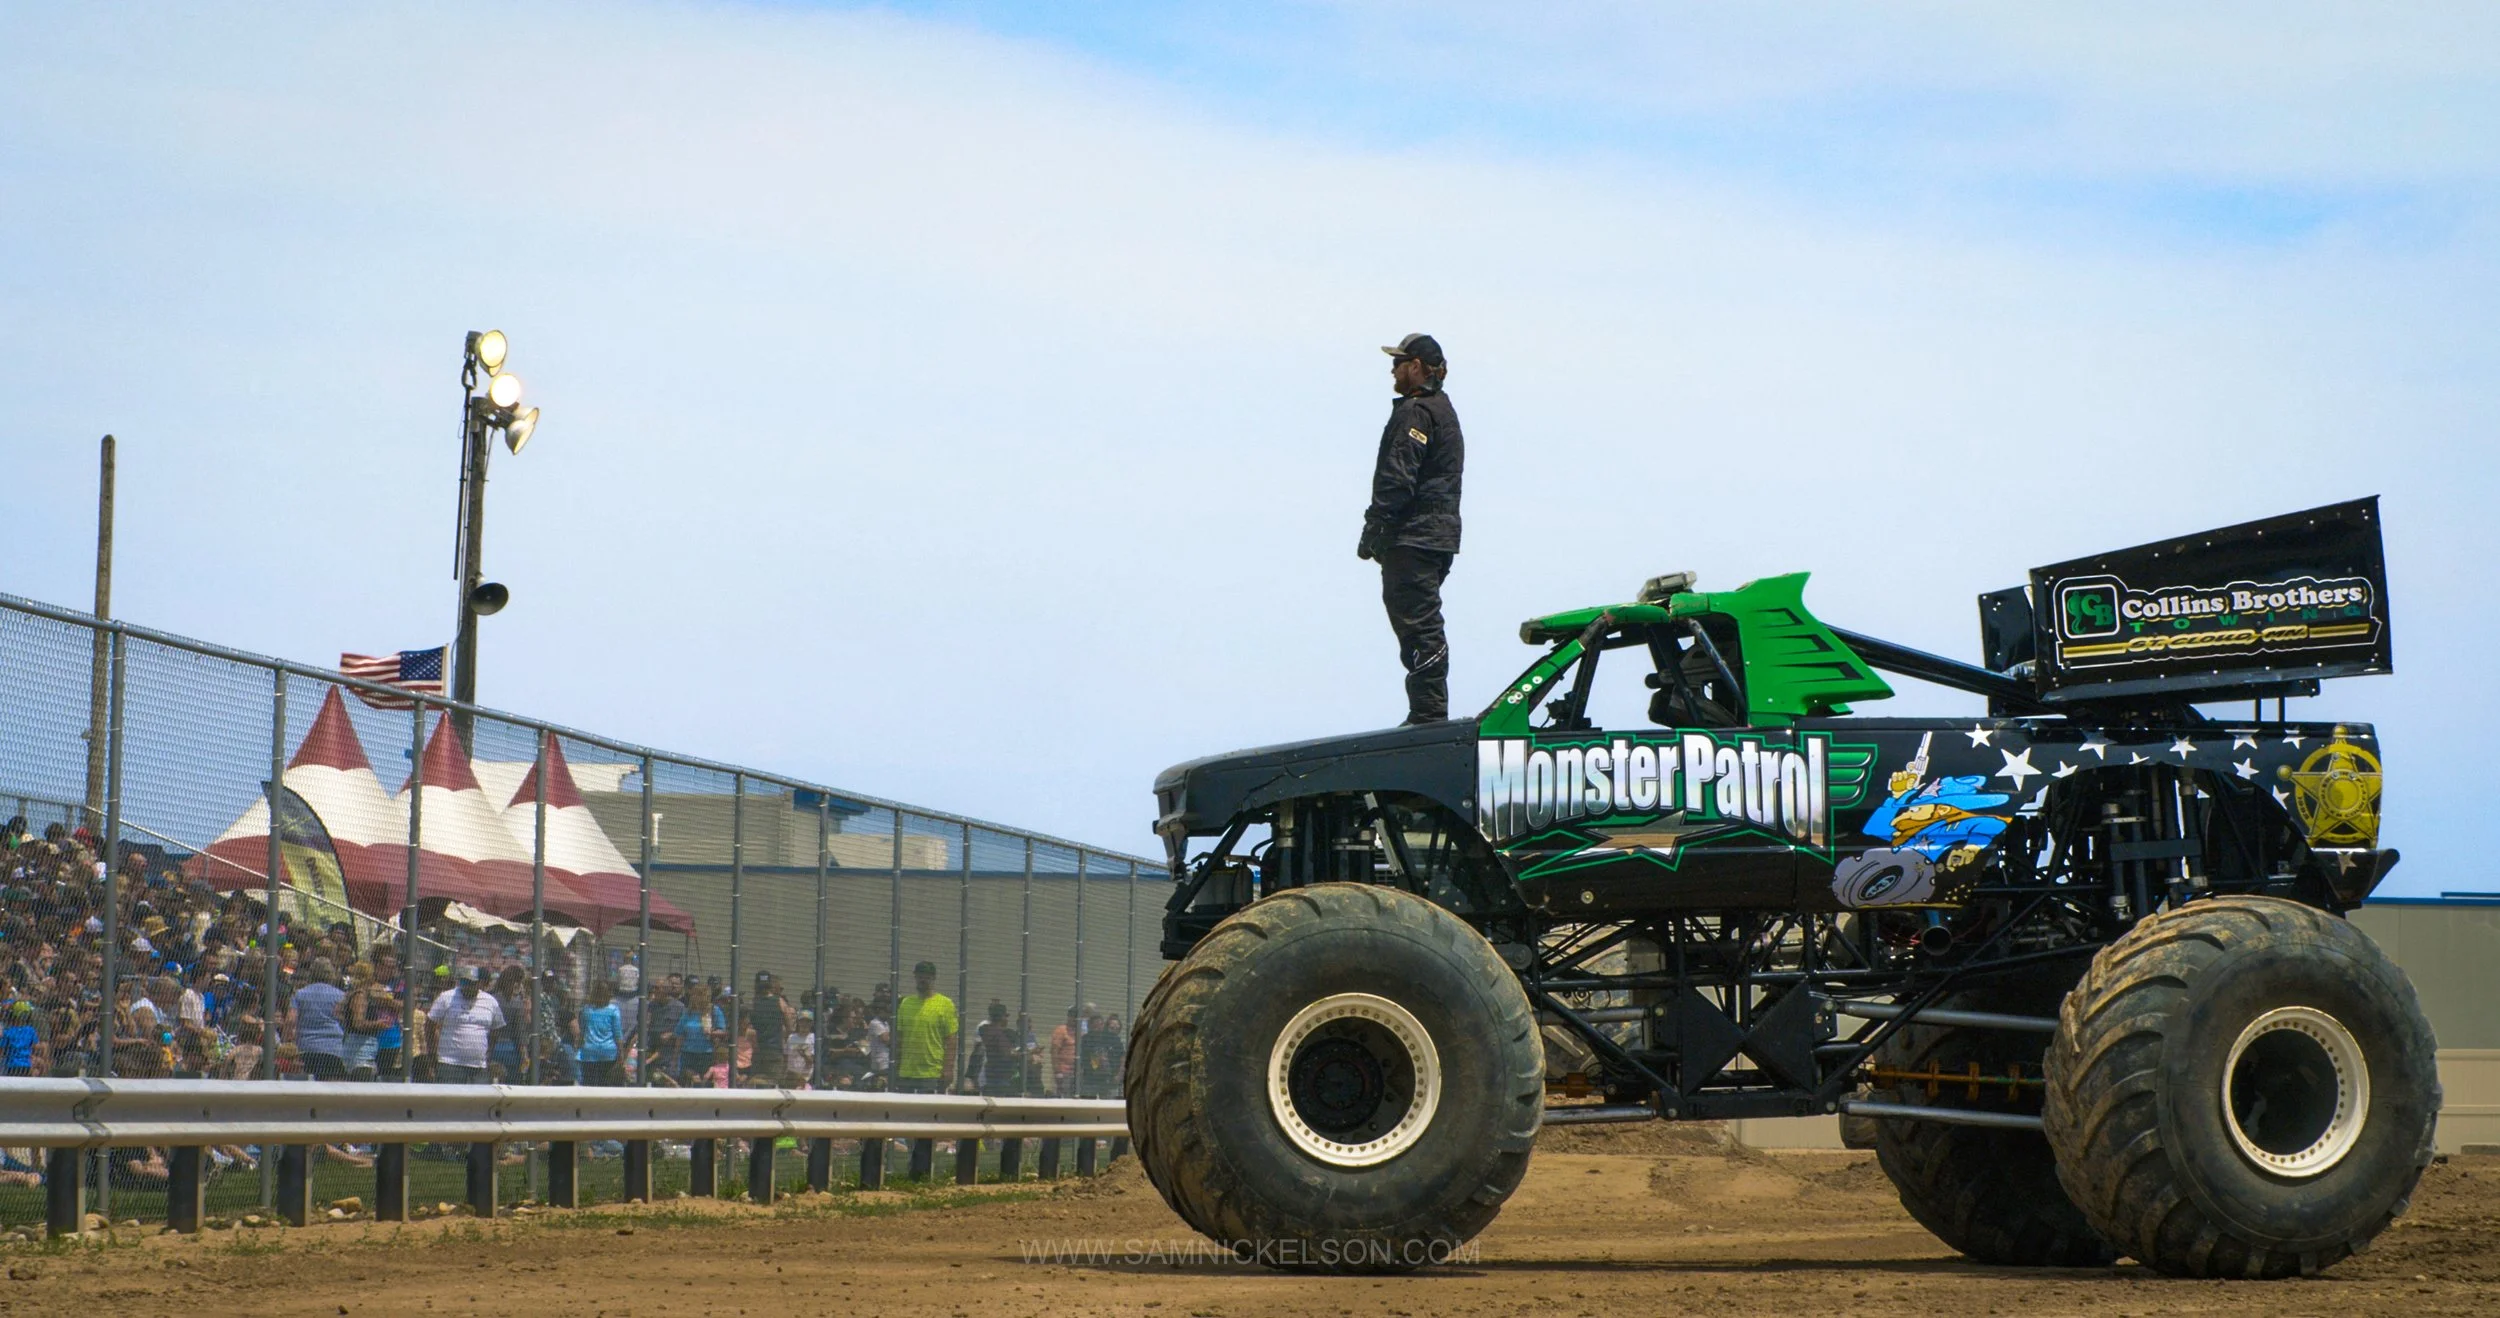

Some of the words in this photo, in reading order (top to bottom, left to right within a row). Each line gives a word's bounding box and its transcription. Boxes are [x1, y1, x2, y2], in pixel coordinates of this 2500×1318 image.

[2121, 595, 2226, 619] Collins
[2231, 586, 2364, 611] Brothers
[2129, 604, 2361, 633] TOWING
[1477, 738, 1680, 841] Monster
[1683, 734, 1825, 850] Patrol
